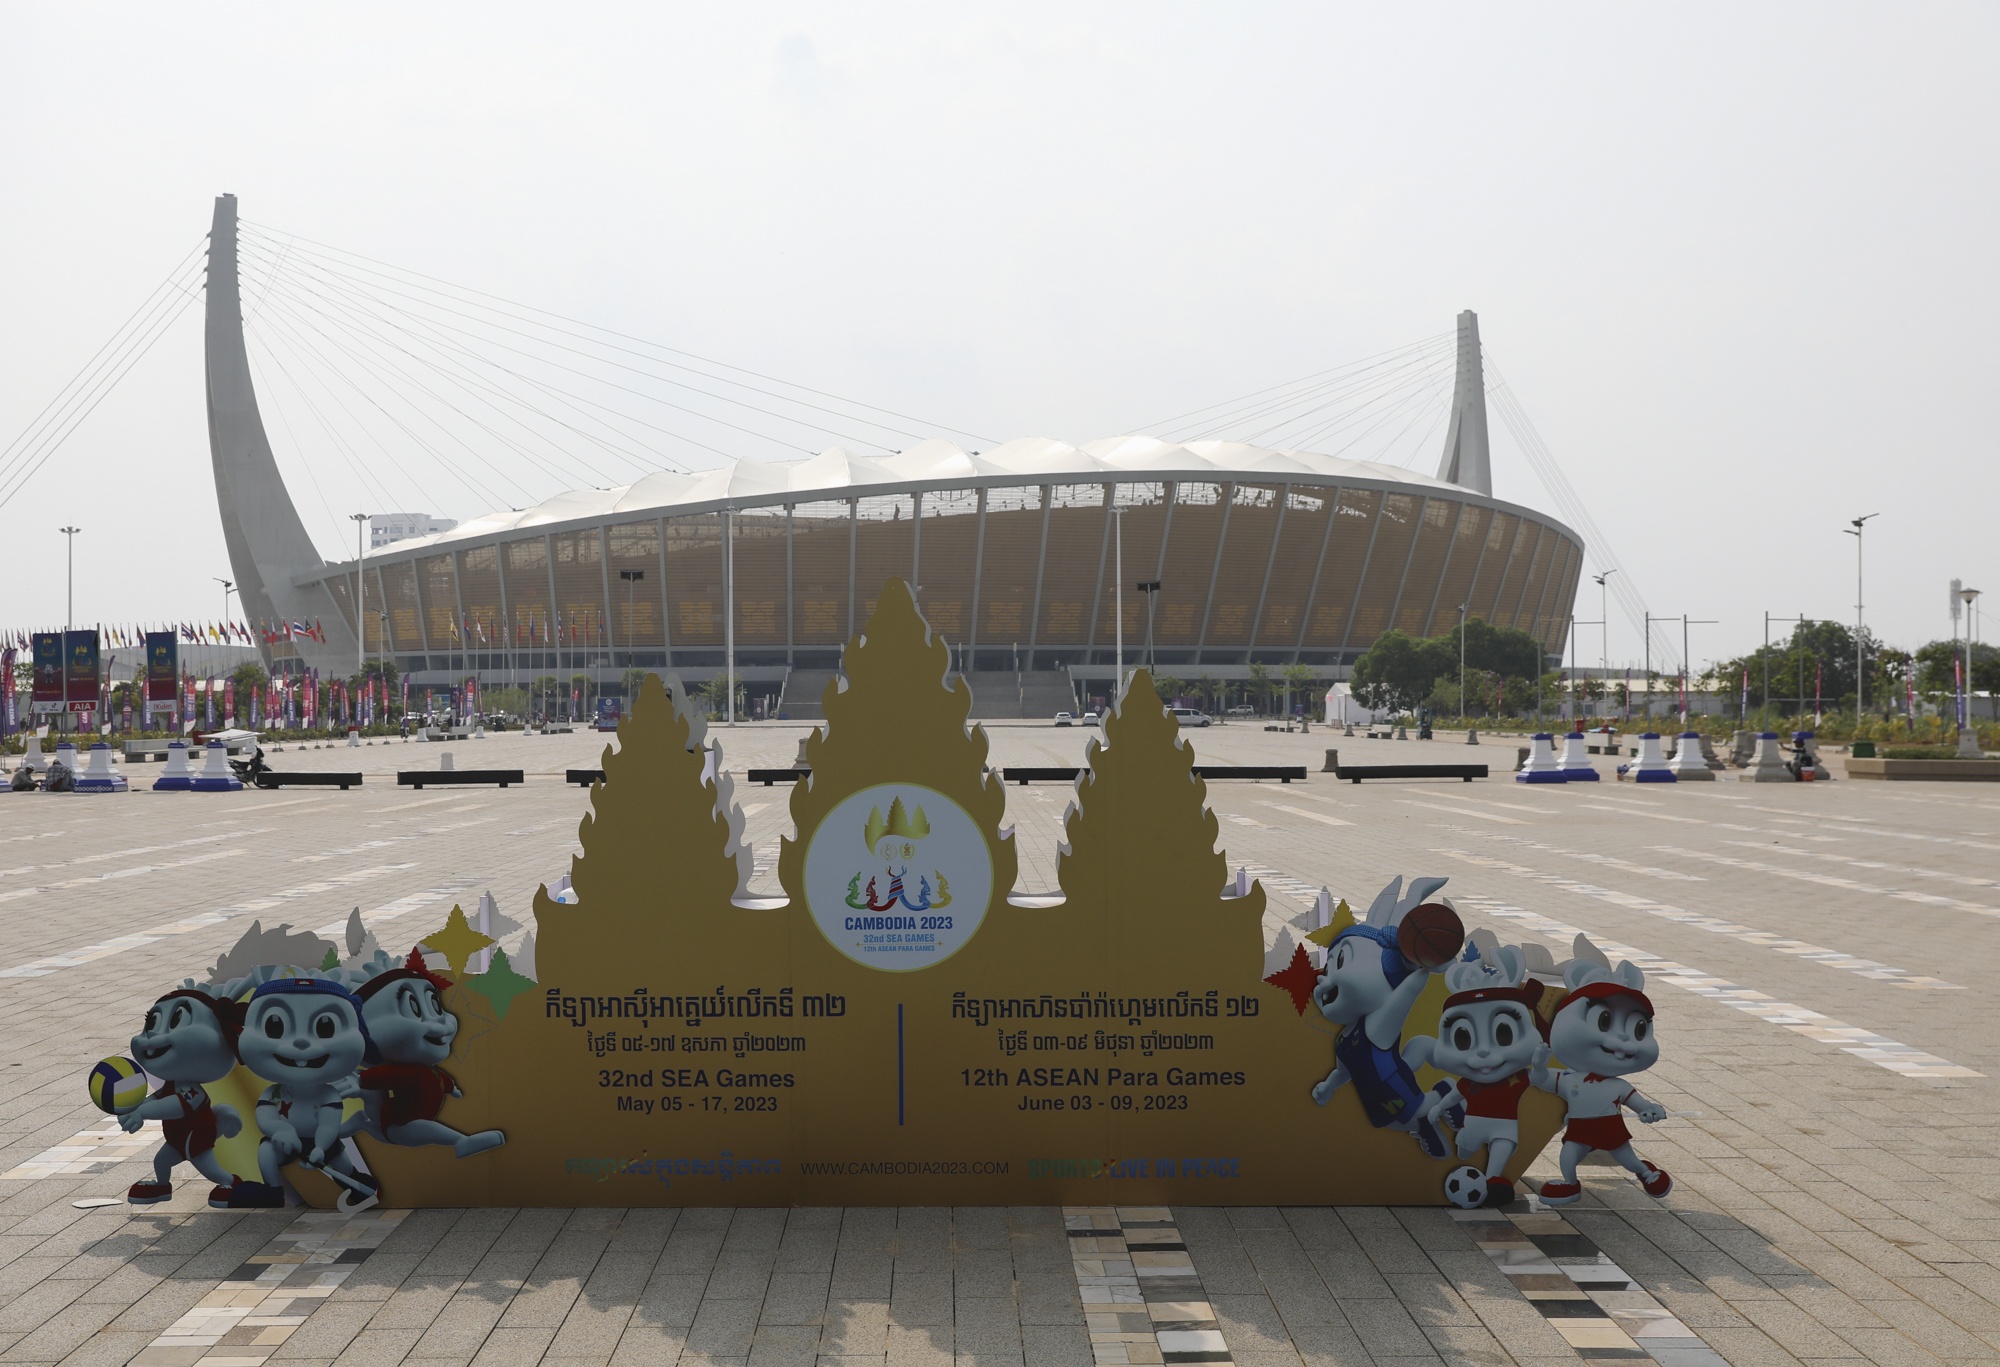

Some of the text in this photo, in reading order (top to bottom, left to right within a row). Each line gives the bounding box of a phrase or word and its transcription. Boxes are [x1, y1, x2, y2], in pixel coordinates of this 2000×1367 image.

[73, 702, 92, 711] AIA
[845, 916, 953, 930] CAMBODIA 2023
[863, 933, 935, 943] 32nd SEA GAMES
[802, 993, 846, 1018] ៣២
[1226, 996, 1260, 1017] ១២
[598, 1069, 795, 1088] 32nd SEA Games
[961, 1067, 1246, 1087] 12th ASEAN Para Games
[617, 1096, 654, 1116] May
[660, 1096, 683, 1112] 05
[701, 1096, 728, 1114] 17,
[734, 1096, 778, 1112] 2023
[1017, 1095, 1065, 1111] June
[1070, 1095, 1092, 1111] 03
[1143, 1095, 1188, 1111] 2023
[800, 1162, 1009, 1176] WWW.CAMBODIA2023.COM
[1028, 1158, 1240, 1179] SPORTS LIVE IN PEACE
